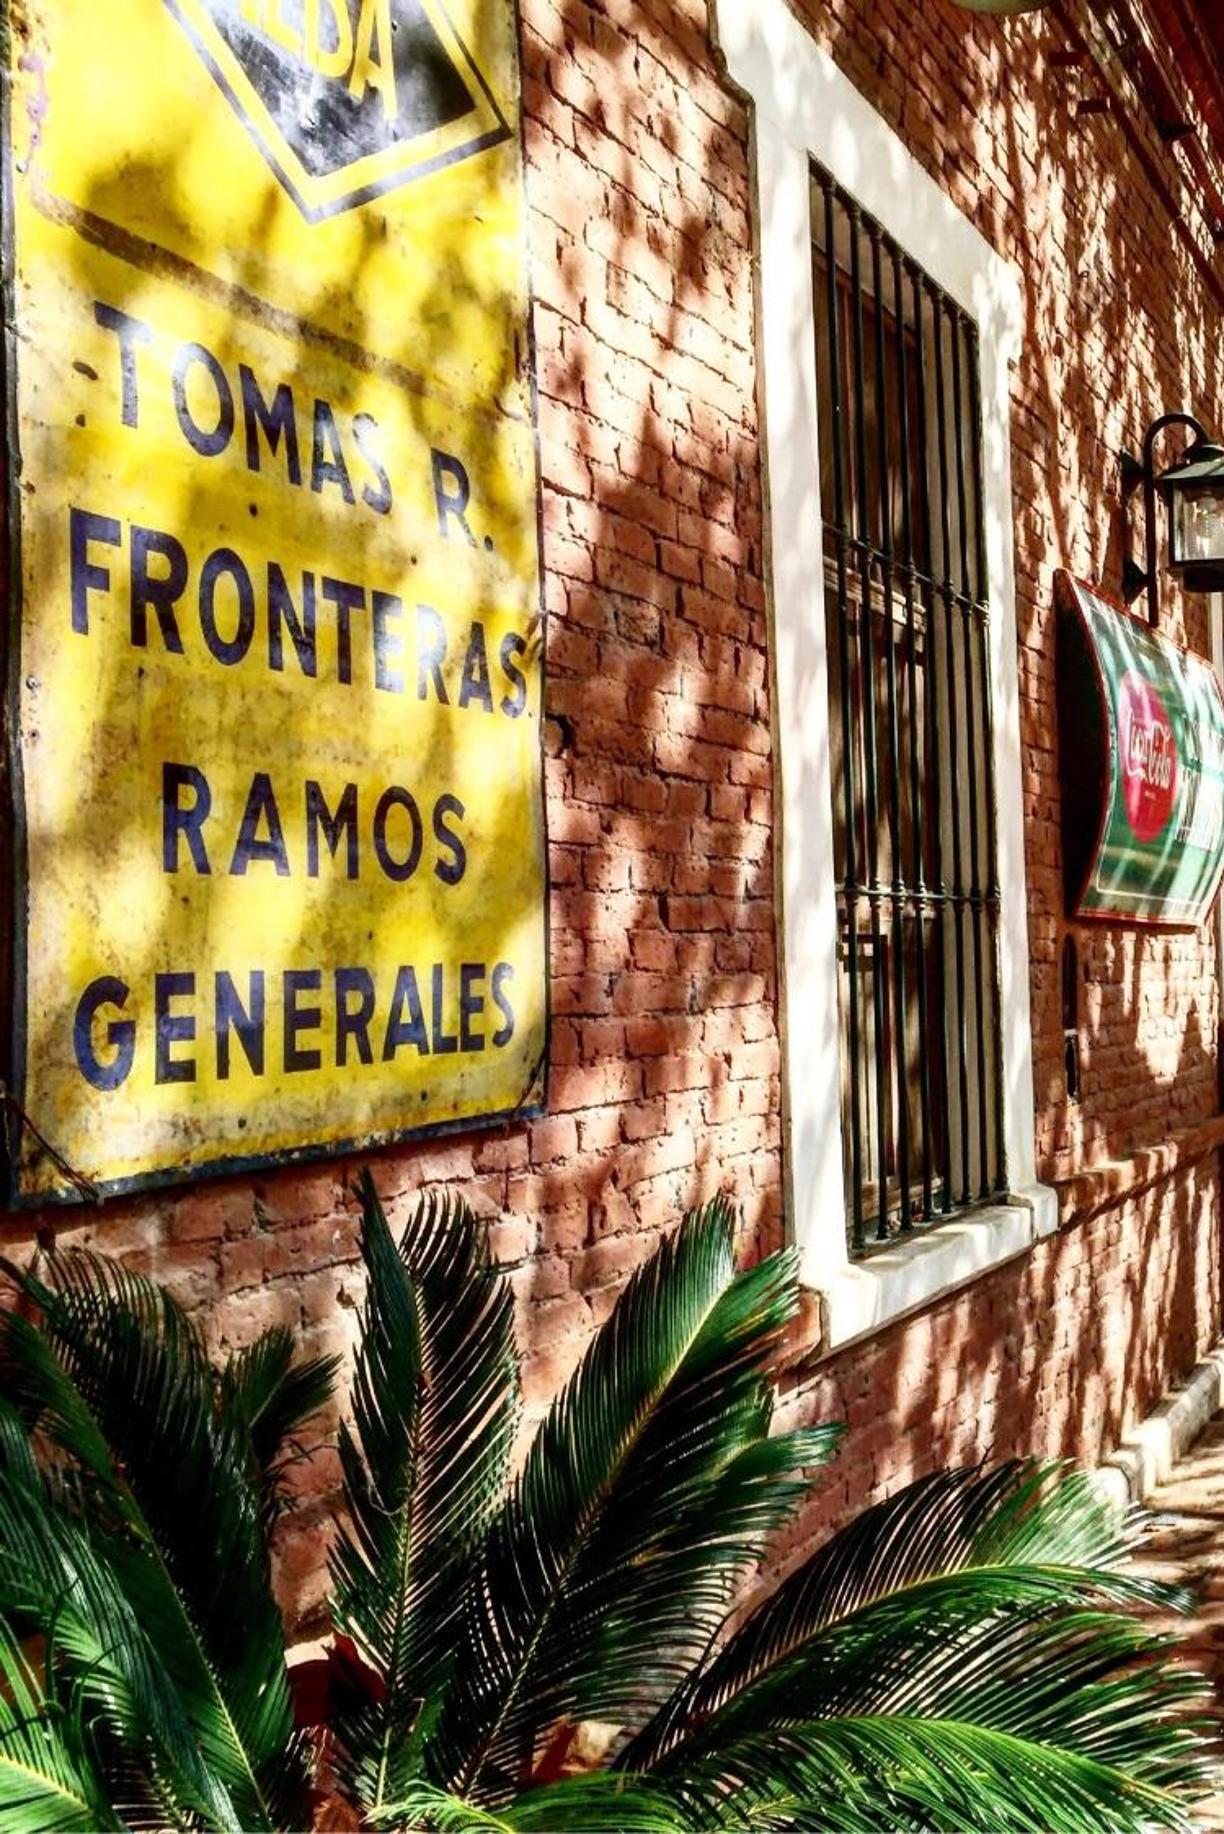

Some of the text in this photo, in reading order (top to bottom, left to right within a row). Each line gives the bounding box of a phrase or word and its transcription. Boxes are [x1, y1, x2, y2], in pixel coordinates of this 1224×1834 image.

[93, 300, 495, 551] TOMAS R.
[69, 506, 527, 718] FRONTERAS
[162, 762, 467, 886] RAMOS
[73, 962, 516, 1091] GENERALES
